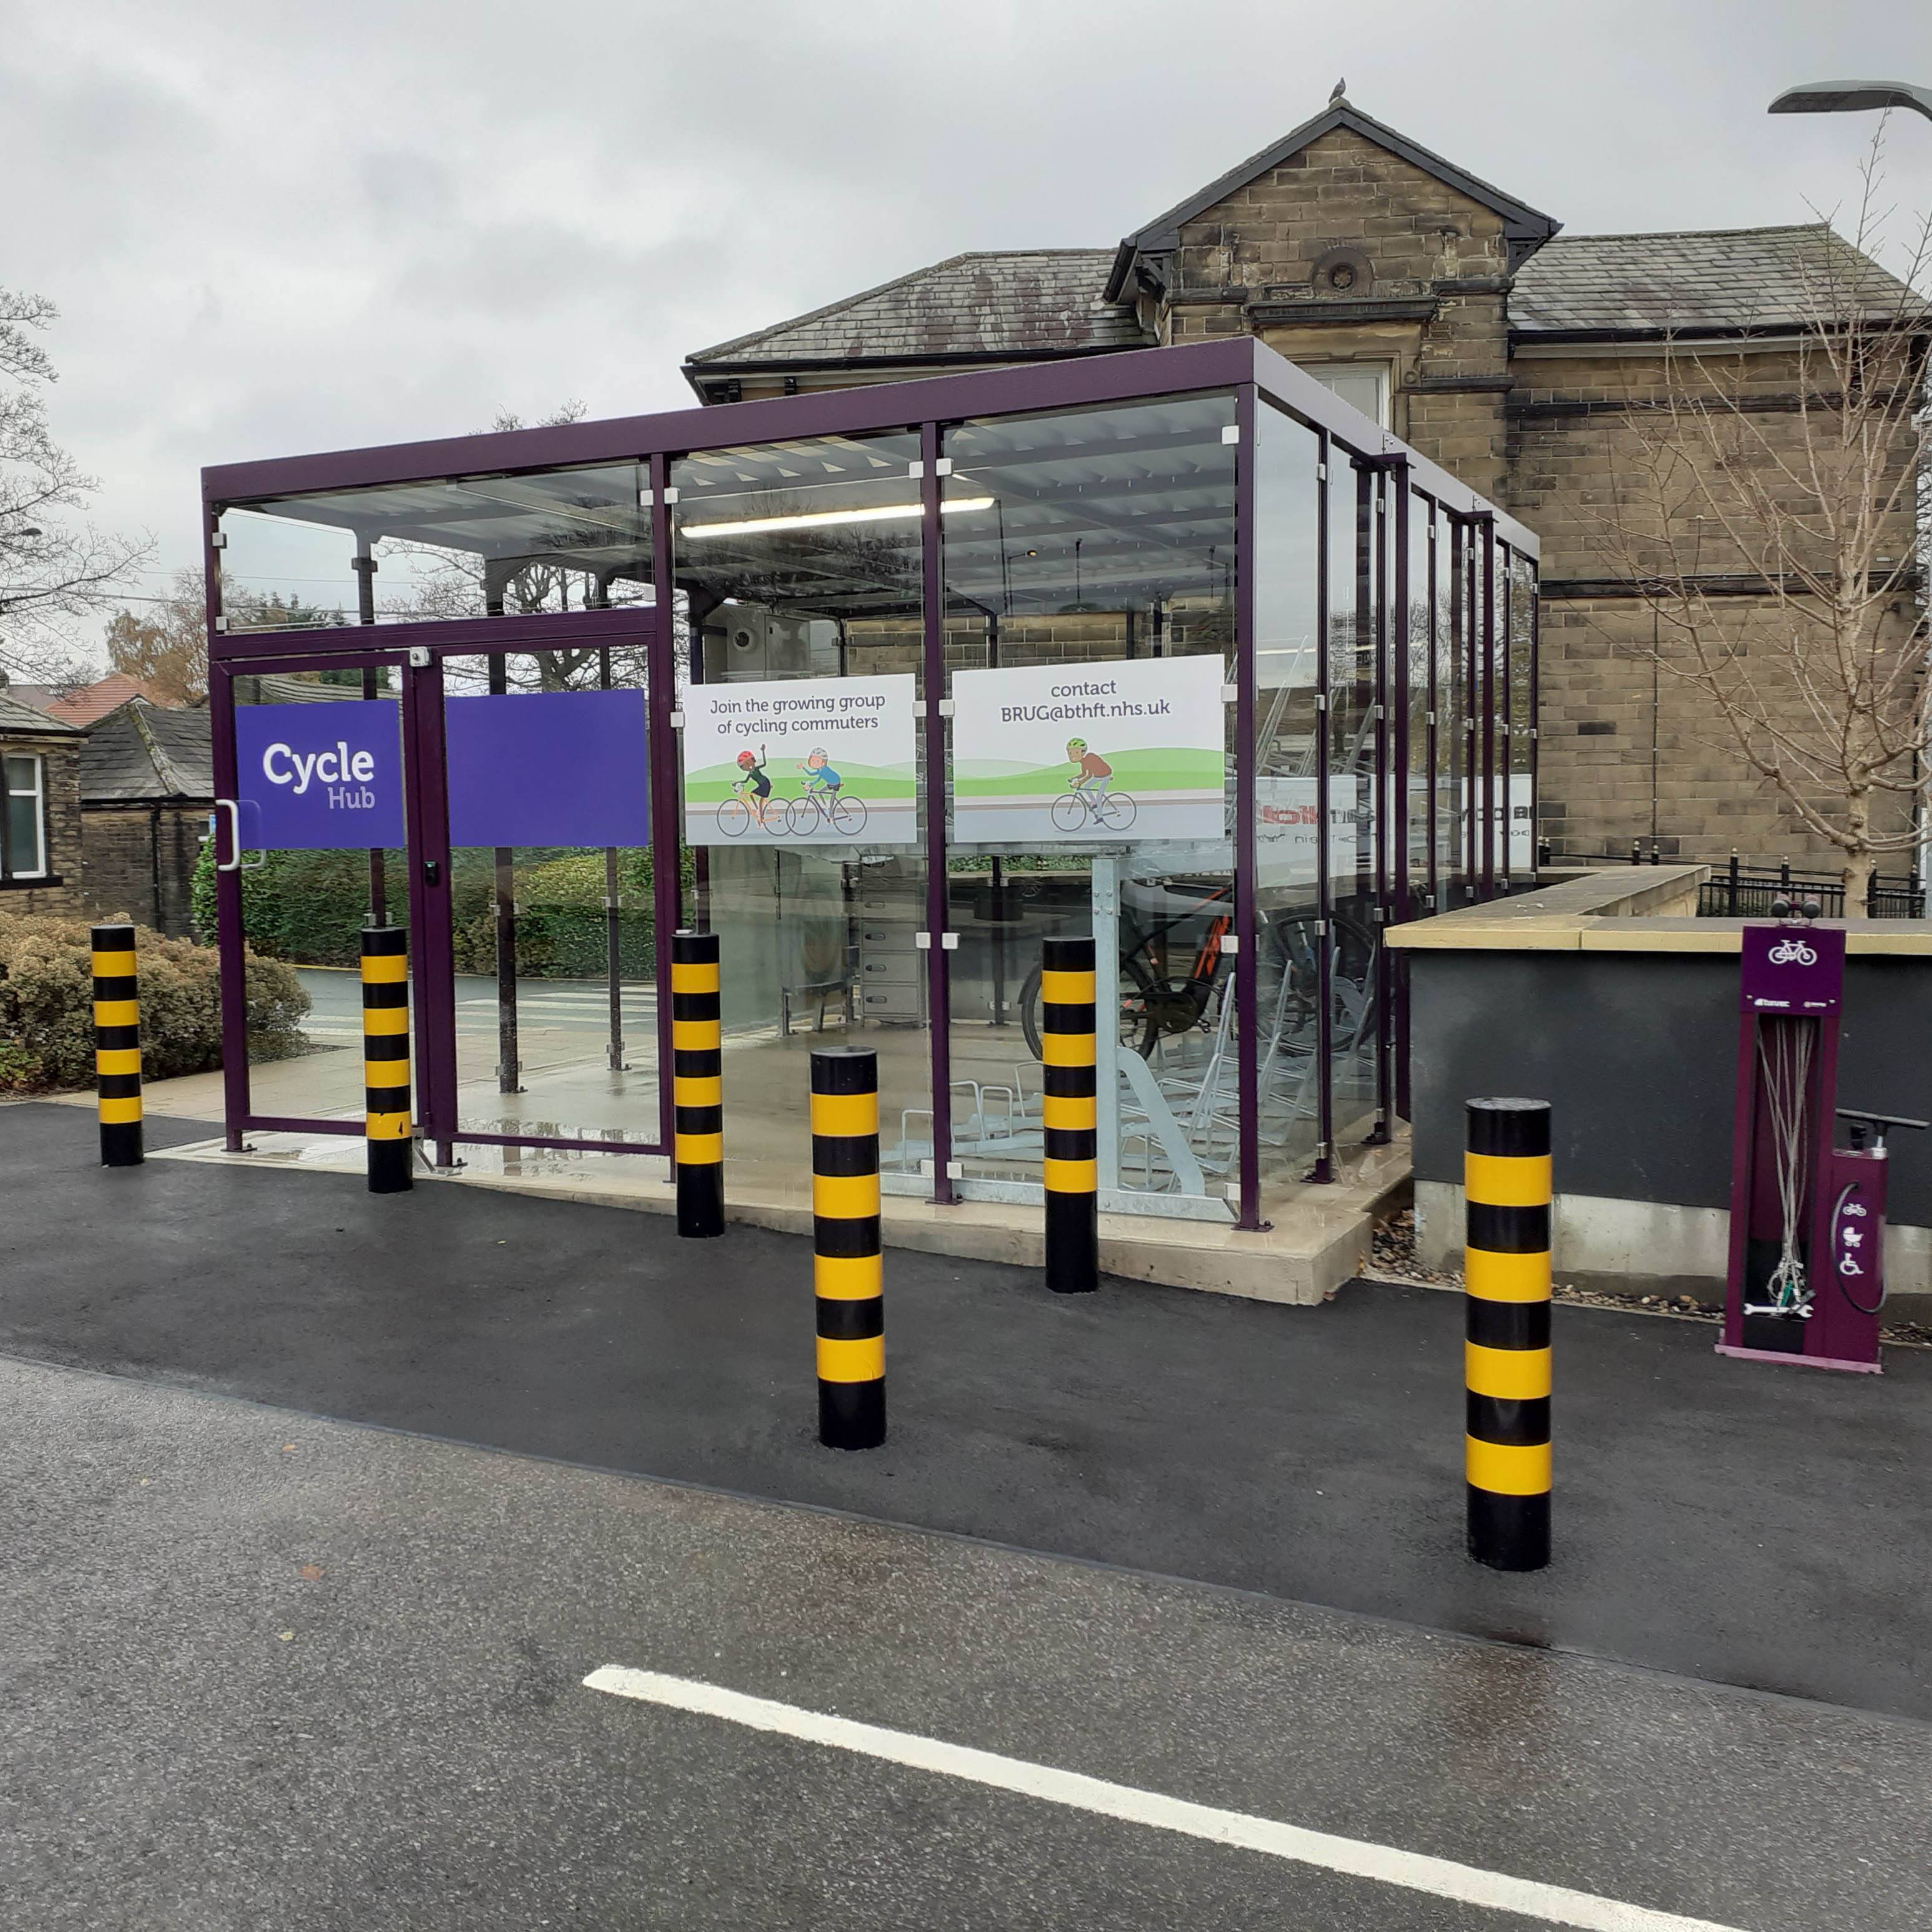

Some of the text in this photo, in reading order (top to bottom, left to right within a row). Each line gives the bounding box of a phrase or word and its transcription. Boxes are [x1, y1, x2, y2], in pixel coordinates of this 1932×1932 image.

[1051, 680, 1117, 698] contact
[710, 695, 886, 715] Join the growing group
[1000, 699, 1171, 722] BRUG@bthft.nhs.uk
[717, 715, 879, 738] of cycling commuters
[263, 741, 374, 794] Cycle
[328, 786, 376, 809] Hub
